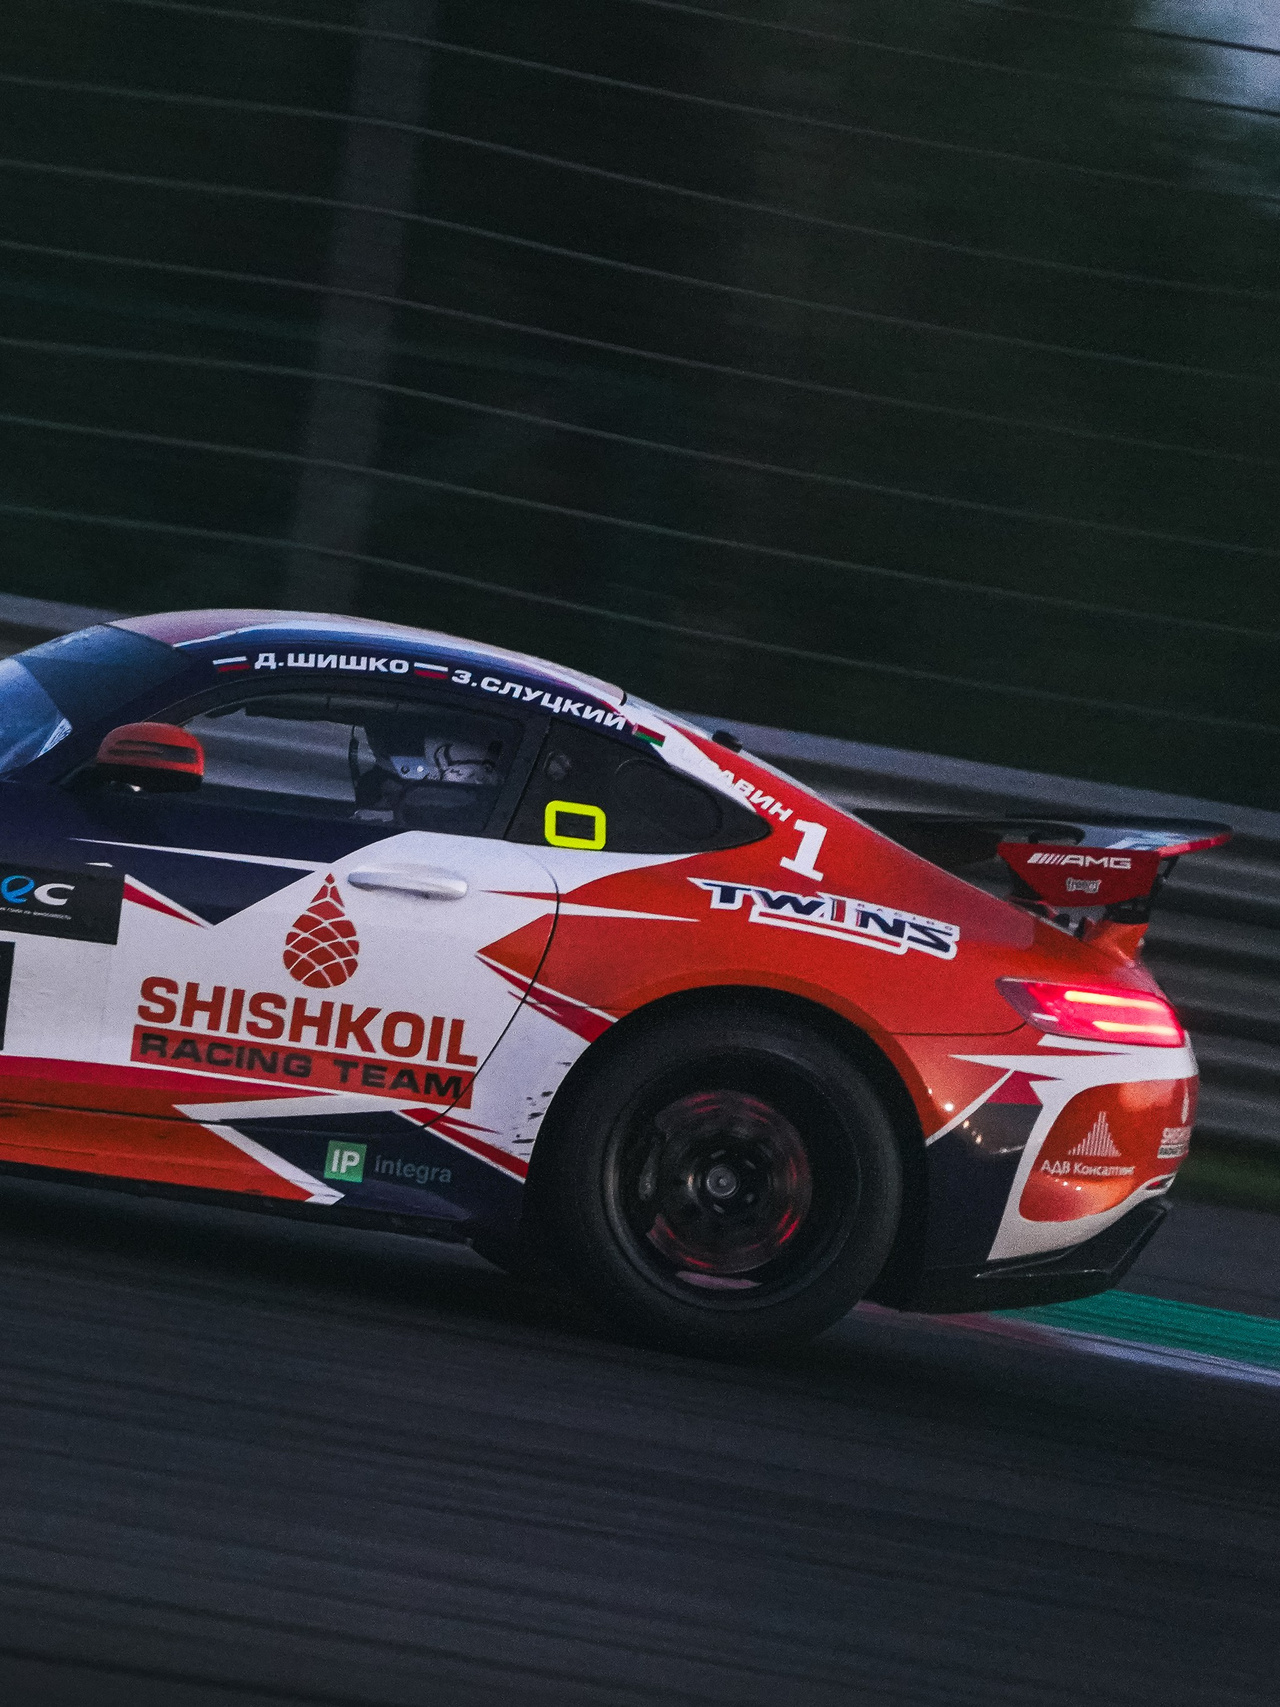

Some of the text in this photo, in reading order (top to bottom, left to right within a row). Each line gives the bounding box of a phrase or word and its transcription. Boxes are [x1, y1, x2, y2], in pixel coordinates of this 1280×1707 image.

[254, 652, 410, 675] Д.ШИШКО
[451, 668, 629, 731] З.СЛУЦКИЙ
[779, 818, 828, 882] 1
[1060, 853, 1133, 870] AMG
[698, 880, 955, 954] TWINS
[136, 975, 480, 1069] SHISHKOIL
[139, 1032, 465, 1100] RACING TEAM
[330, 1148, 452, 1185] IP integra
[1040, 1159, 1071, 1176] АДВ
